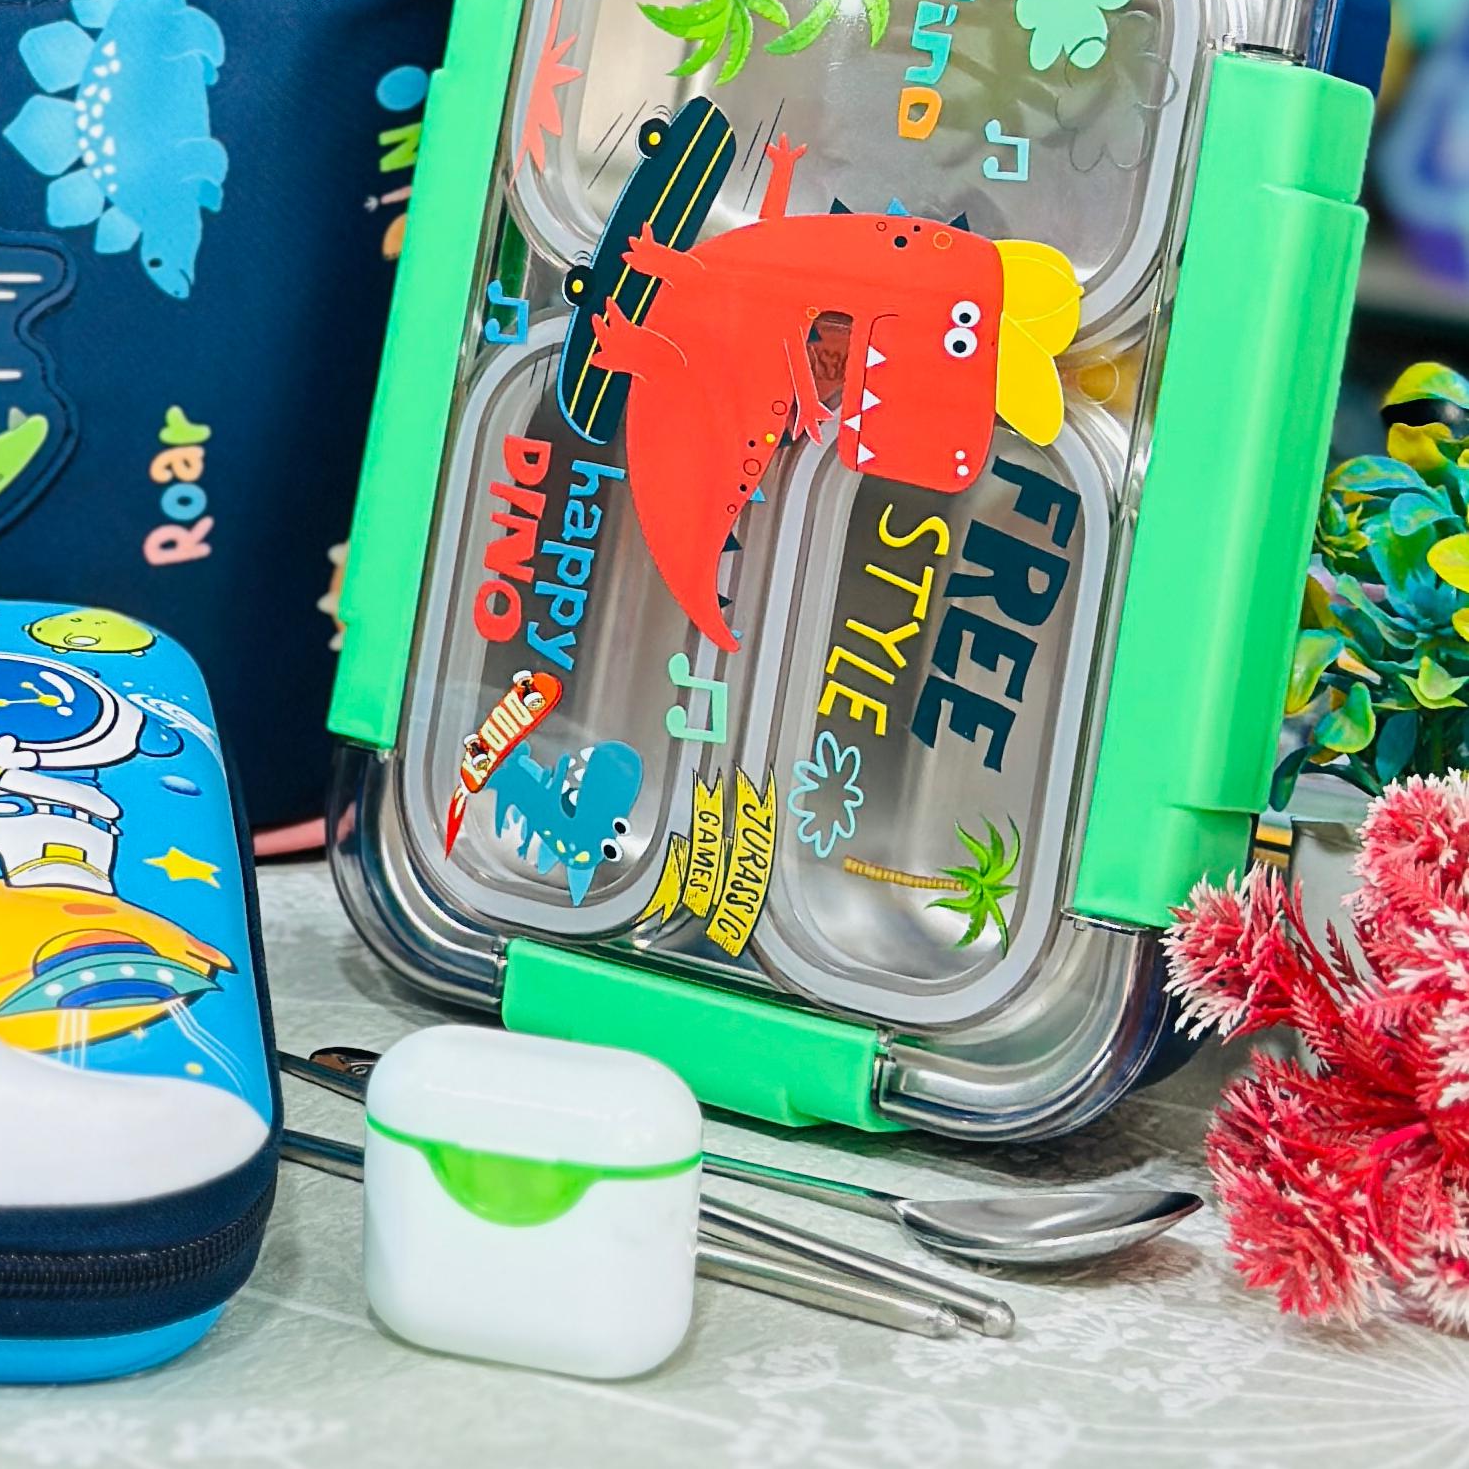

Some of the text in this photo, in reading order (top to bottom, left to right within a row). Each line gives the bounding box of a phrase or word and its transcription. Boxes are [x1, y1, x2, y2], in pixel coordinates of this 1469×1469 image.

[143, 405, 214, 566] Roar
[473, 434, 552, 642] DINO
[527, 459, 626, 671] happy
[817, 503, 950, 736] STYLE
[911, 455, 1081, 772] FREE
[689, 810, 721, 893] GAMES
[716, 803, 772, 940] JURASSIC
